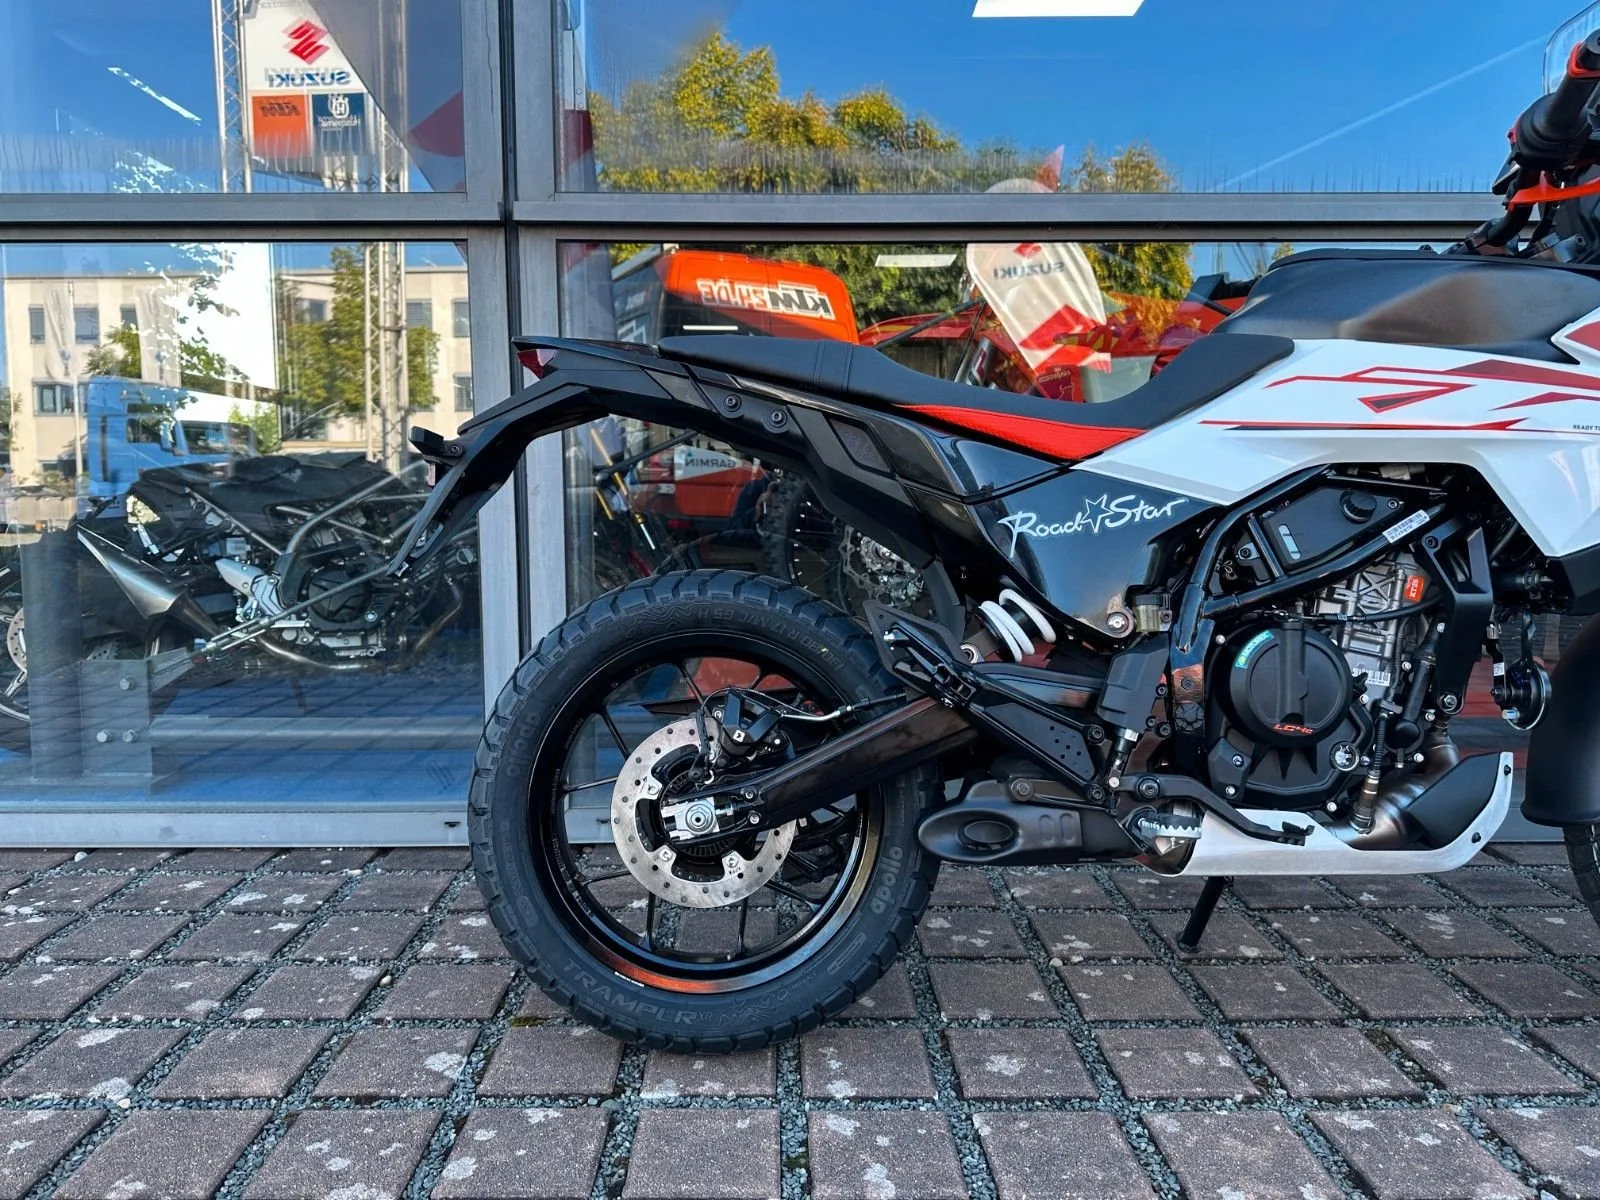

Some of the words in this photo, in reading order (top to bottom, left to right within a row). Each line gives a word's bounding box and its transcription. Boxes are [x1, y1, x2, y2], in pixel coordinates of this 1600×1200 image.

[998, 507, 1085, 559] Road
[1105, 494, 1190, 529] Star
[508, 712, 538, 778] apollo
[870, 844, 905, 914] apollo
[563, 958, 698, 1025] TRAMPLR
